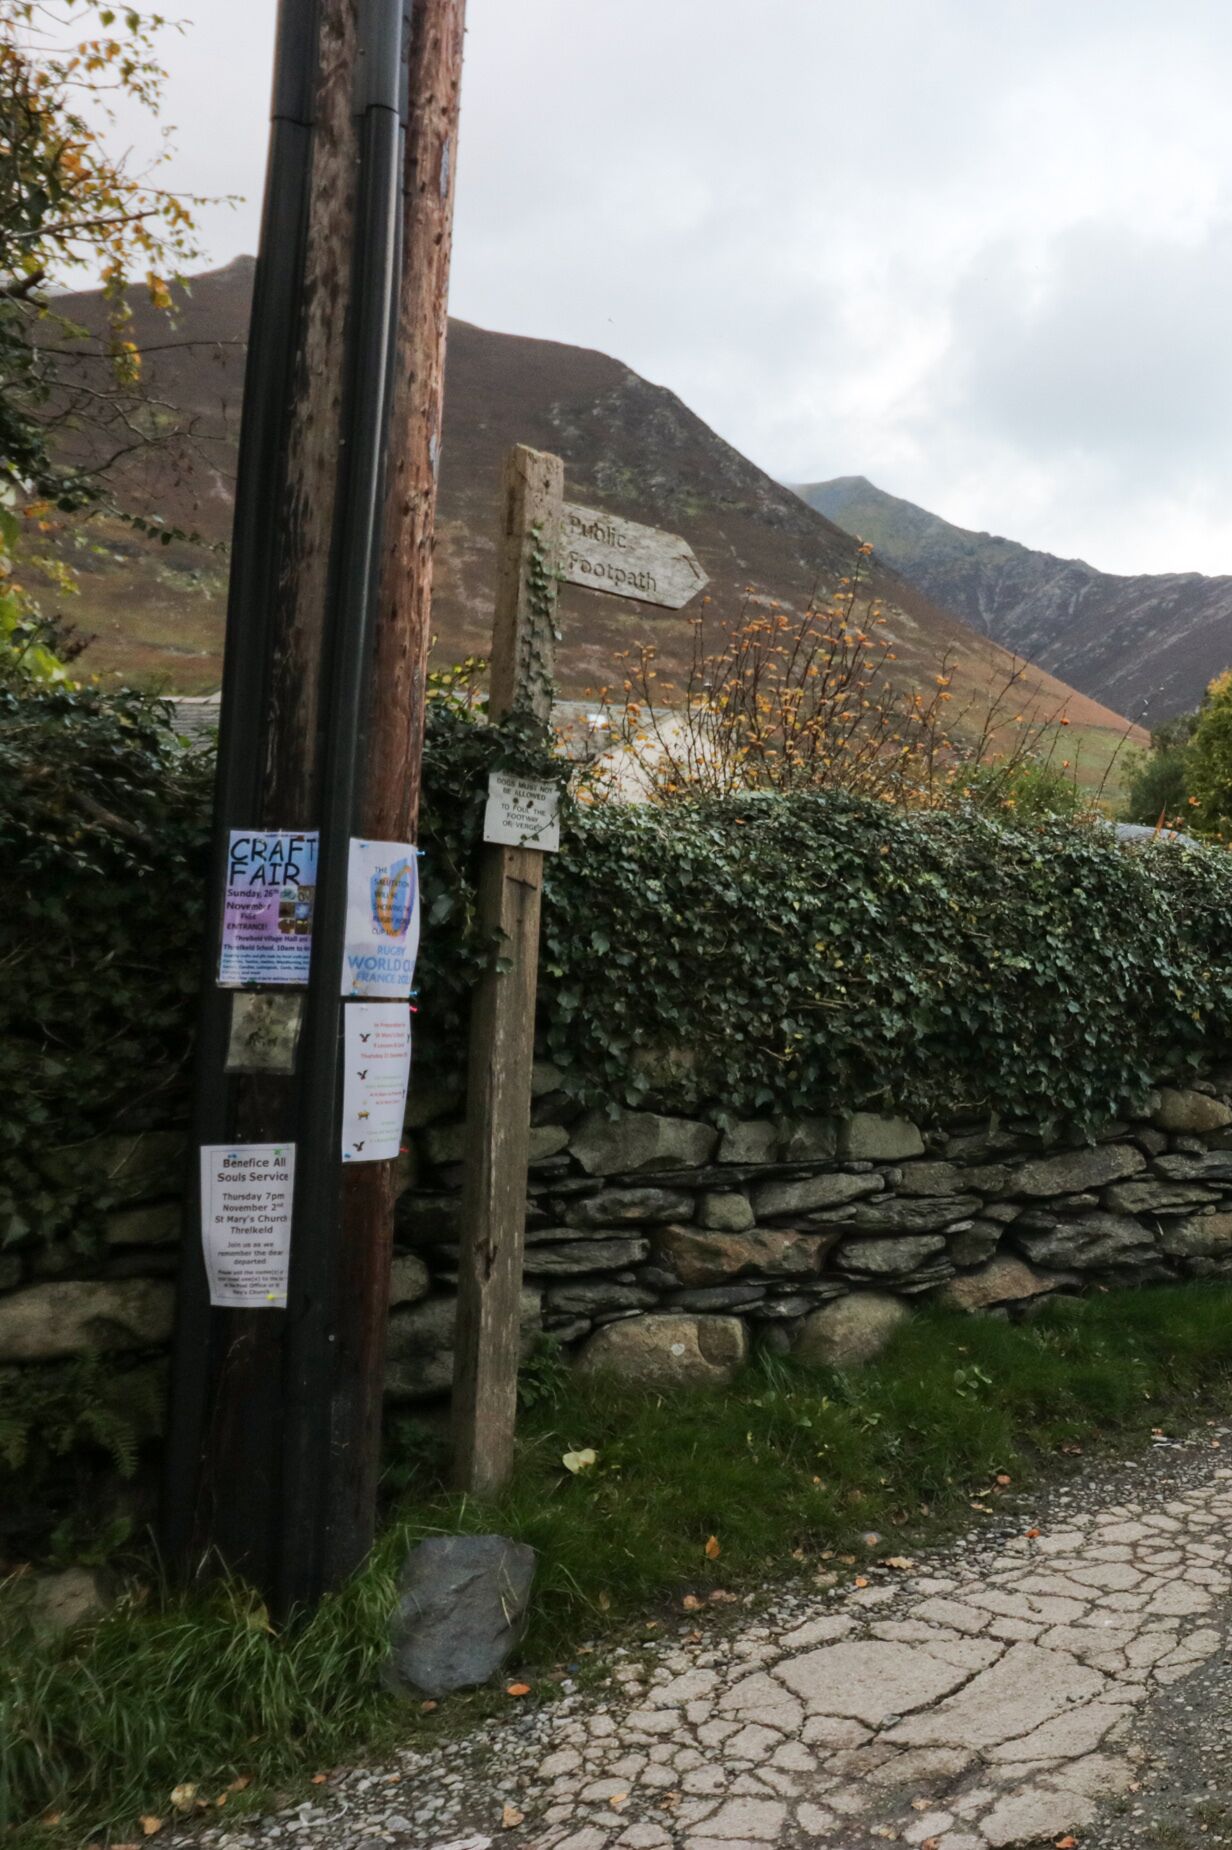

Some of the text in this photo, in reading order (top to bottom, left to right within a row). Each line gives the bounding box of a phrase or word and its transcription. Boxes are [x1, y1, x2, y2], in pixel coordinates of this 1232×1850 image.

[569, 514, 627, 548] Public
[568, 551, 657, 592] Footpath
[497, 778, 553, 794] DOGS MUST NOT
[515, 790, 546, 801] ALLOWED
[501, 803, 510, 811] TO
[534, 809, 546, 817] THE
[507, 812, 538, 823] FOOTWAY
[231, 838, 317, 862] CRAFT
[230, 861, 300, 886] FAIR
[226, 902, 271, 910] November
[377, 945, 407, 956] RUGBY
[347, 956, 398, 971] WORLD
[356, 972, 395, 983] FRANCE
[223, 1158, 286, 1168] Benefice All
[217, 1172, 289, 1182] Souls Service
[222, 1192, 285, 1201] Thursday 7pm
[222, 1204, 268, 1212] November
[215, 1215, 223, 1223] St
[227, 1215, 255, 1224] Mary's
